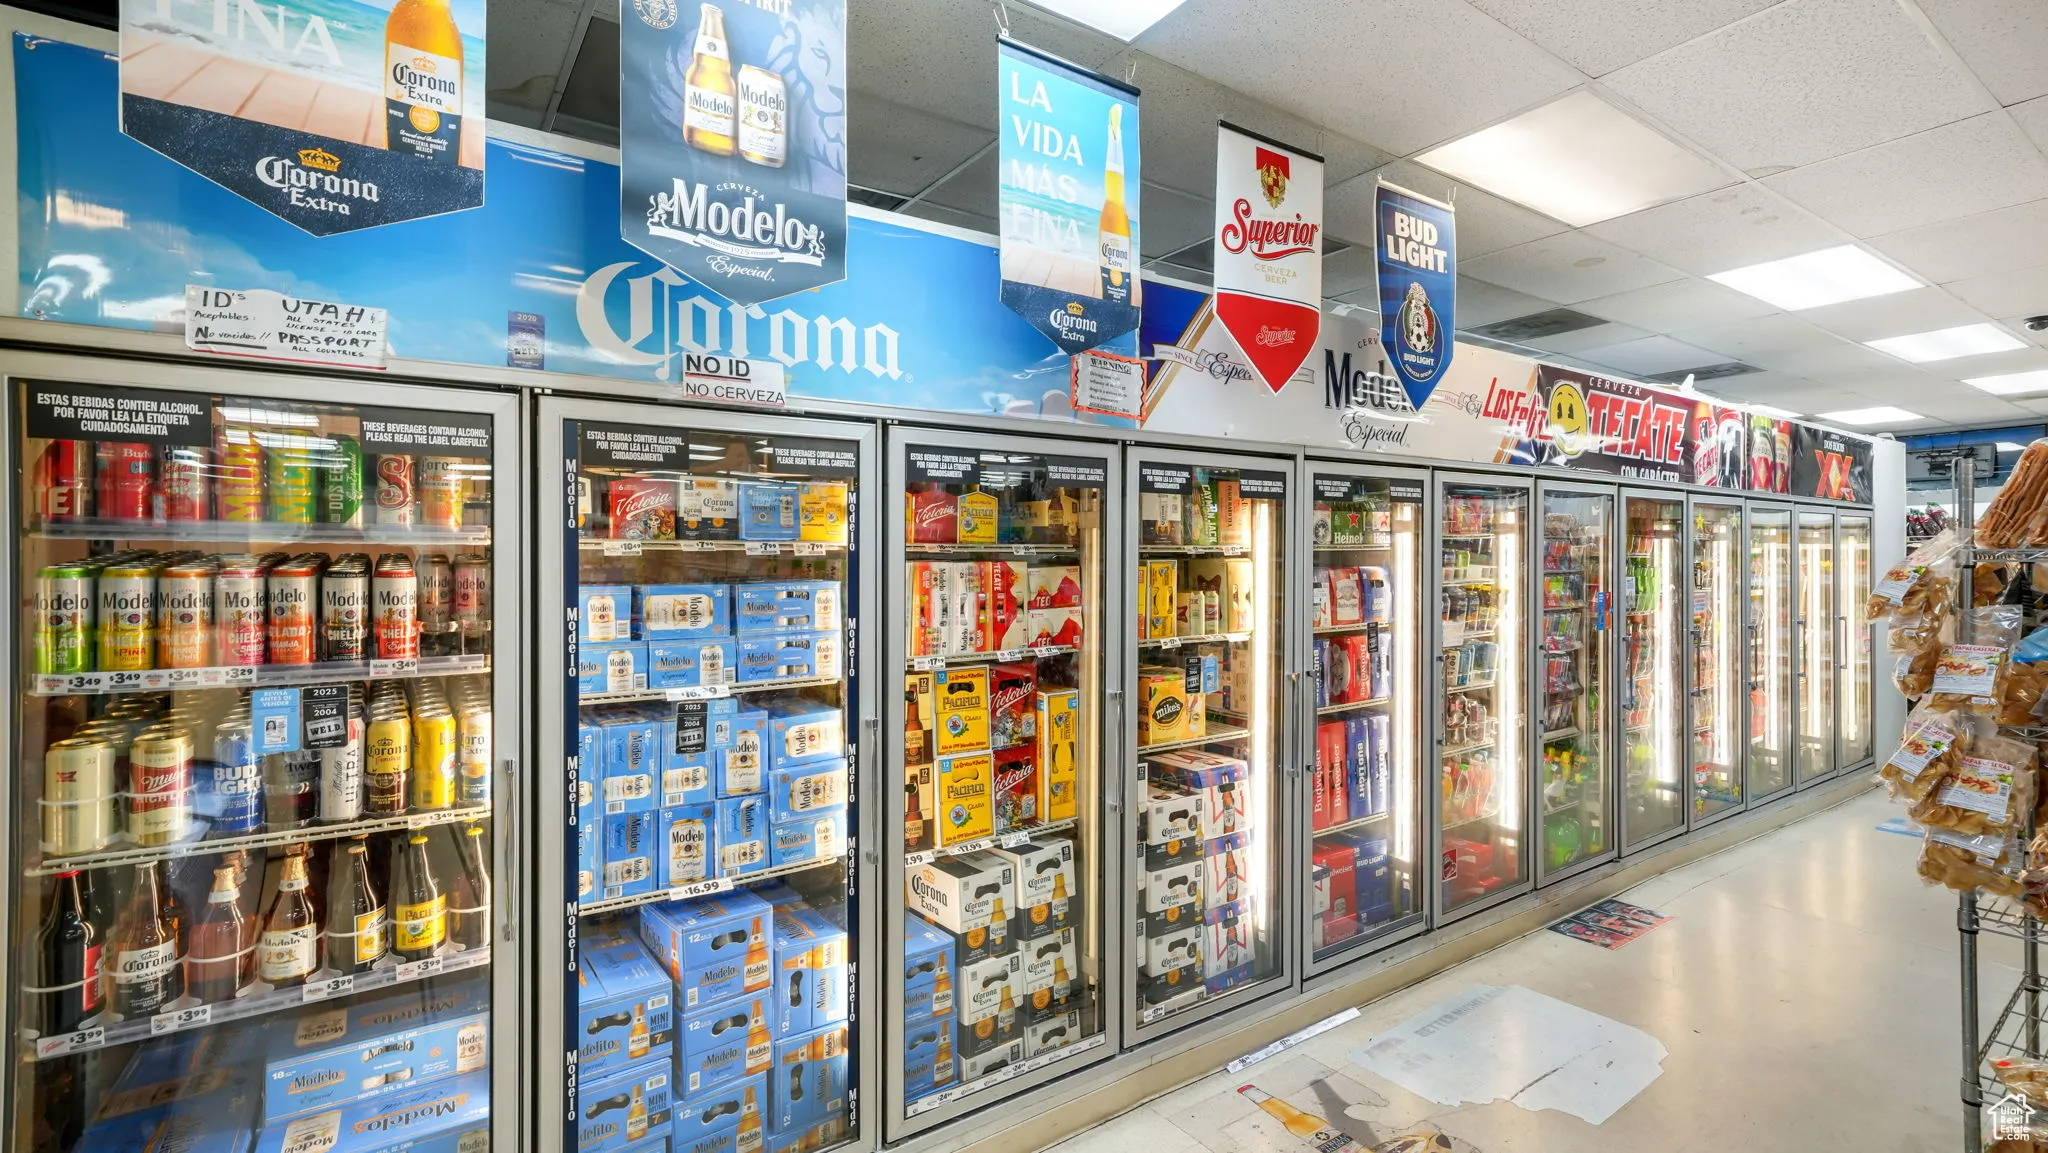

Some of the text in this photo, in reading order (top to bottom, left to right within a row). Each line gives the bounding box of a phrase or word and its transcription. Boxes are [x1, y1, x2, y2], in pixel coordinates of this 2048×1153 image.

[392, 63, 455, 95] Corona
[408, 86, 442, 105] Extra
[740, 83, 785, 112] Modelo
[1012, 71, 1053, 114] LA
[1012, 115, 1084, 166] VIDA
[255, 155, 379, 203] Corona
[1012, 157, 1078, 203] MÁS
[716, 181, 766, 201] CERVEZA
[291, 188, 350, 216] Extra
[672, 178, 806, 250] Modelo
[1013, 202, 1083, 250] FINA
[1222, 198, 1320, 258] Superior
[1394, 212, 1438, 248] BUD
[730, 246, 751, 256] 1925
[1387, 235, 1446, 273] LIGHT
[1254, 263, 1298, 279] CERVEZA
[1265, 275, 1288, 286] BEER
[282, 300, 365, 323] UTAH
[517, 313, 537, 322] 2020
[576, 262, 903, 380] Corona
[1050, 308, 1097, 333] Corona
[286, 323, 326, 332] LICENSE
[313, 318, 355, 328] STATES
[1062, 323, 1085, 342] Extra
[195, 326, 215, 340] No
[278, 332, 376, 349] PASSPORT
[1256, 325, 1295, 347] Superior
[292, 345, 365, 358] ALL COUNTRIES
[1174, 350, 1193, 365] SINCE
[1404, 353, 1434, 366] BUD LIGHT
[686, 354, 751, 378] NO ID
[686, 383, 785, 405] NO CERVEZA
[1590, 377, 1641, 396] CERVEZA
[37, 393, 203, 415] ESTAS BEBIDAS CONTIEN ALCOHOL.
[54, 407, 190, 426] POR FAVOR LEA LA ETIQUETA
[81, 420, 168, 436] CUIDADOSAMENTA
[363, 421, 386, 432] THESE
[387, 423, 427, 434] BEVERAGES
[428, 426, 456, 436] CONTAIN
[1587, 389, 1685, 465] TECATE
[366, 431, 488, 448] PLEASE READ THE LABEL CAREFULLY.
[587, 431, 685, 445] ESTAS BEBIDAS CONTIEN ALCOHOL.
[596, 440, 676, 454] POR FAVOR LEA LA ETIQUETA
[612, 450, 664, 462] CUIDADOSAMENTA
[776, 456, 793, 465] PLEASE
[794, 457, 806, 466] READ
[806, 457, 816, 466] THE
[817, 459, 831, 467] LABEL
[329, 485, 344, 510] DOS
[566, 459, 577, 529] Modelo
[616, 487, 672, 519] Victoria
[848, 492, 856, 551] Modelo
[916, 500, 957, 528] Victoria
[313, 687, 337, 696] 2025
[990, 680, 1034, 713] Victoria
[314, 708, 337, 717] 2004
[943, 696, 981, 710] PACIFICO
[1156, 702, 1182, 719] mike's
[213, 766, 258, 782] BUD
[1334, 744, 1342, 808] Budweiser
[1358, 764, 1366, 800] LIGHT
[567, 756, 578, 825] Modelo
[947, 783, 985, 799] PACIFICO
[1357, 854, 1385, 867] BUD LIGHT
[684, 881, 720, 895] $16.99
[912, 873, 948, 907] Corona
[921, 897, 940, 915] Extra
[965, 899, 989, 912] Corona
[688, 934, 701, 943] 12
[123, 952, 173, 971] Corona
[1028, 960, 1051, 974] Corona
[973, 988, 997, 1003] Corona
[650, 1012, 669, 1024] MINI
[688, 1020, 701, 1031] 12
[566, 1050, 577, 1121] Modelo
[648, 1091, 667, 1105] MINI
[367, 1100, 456, 1131] Modelo
[679, 1110, 692, 1120] 12
